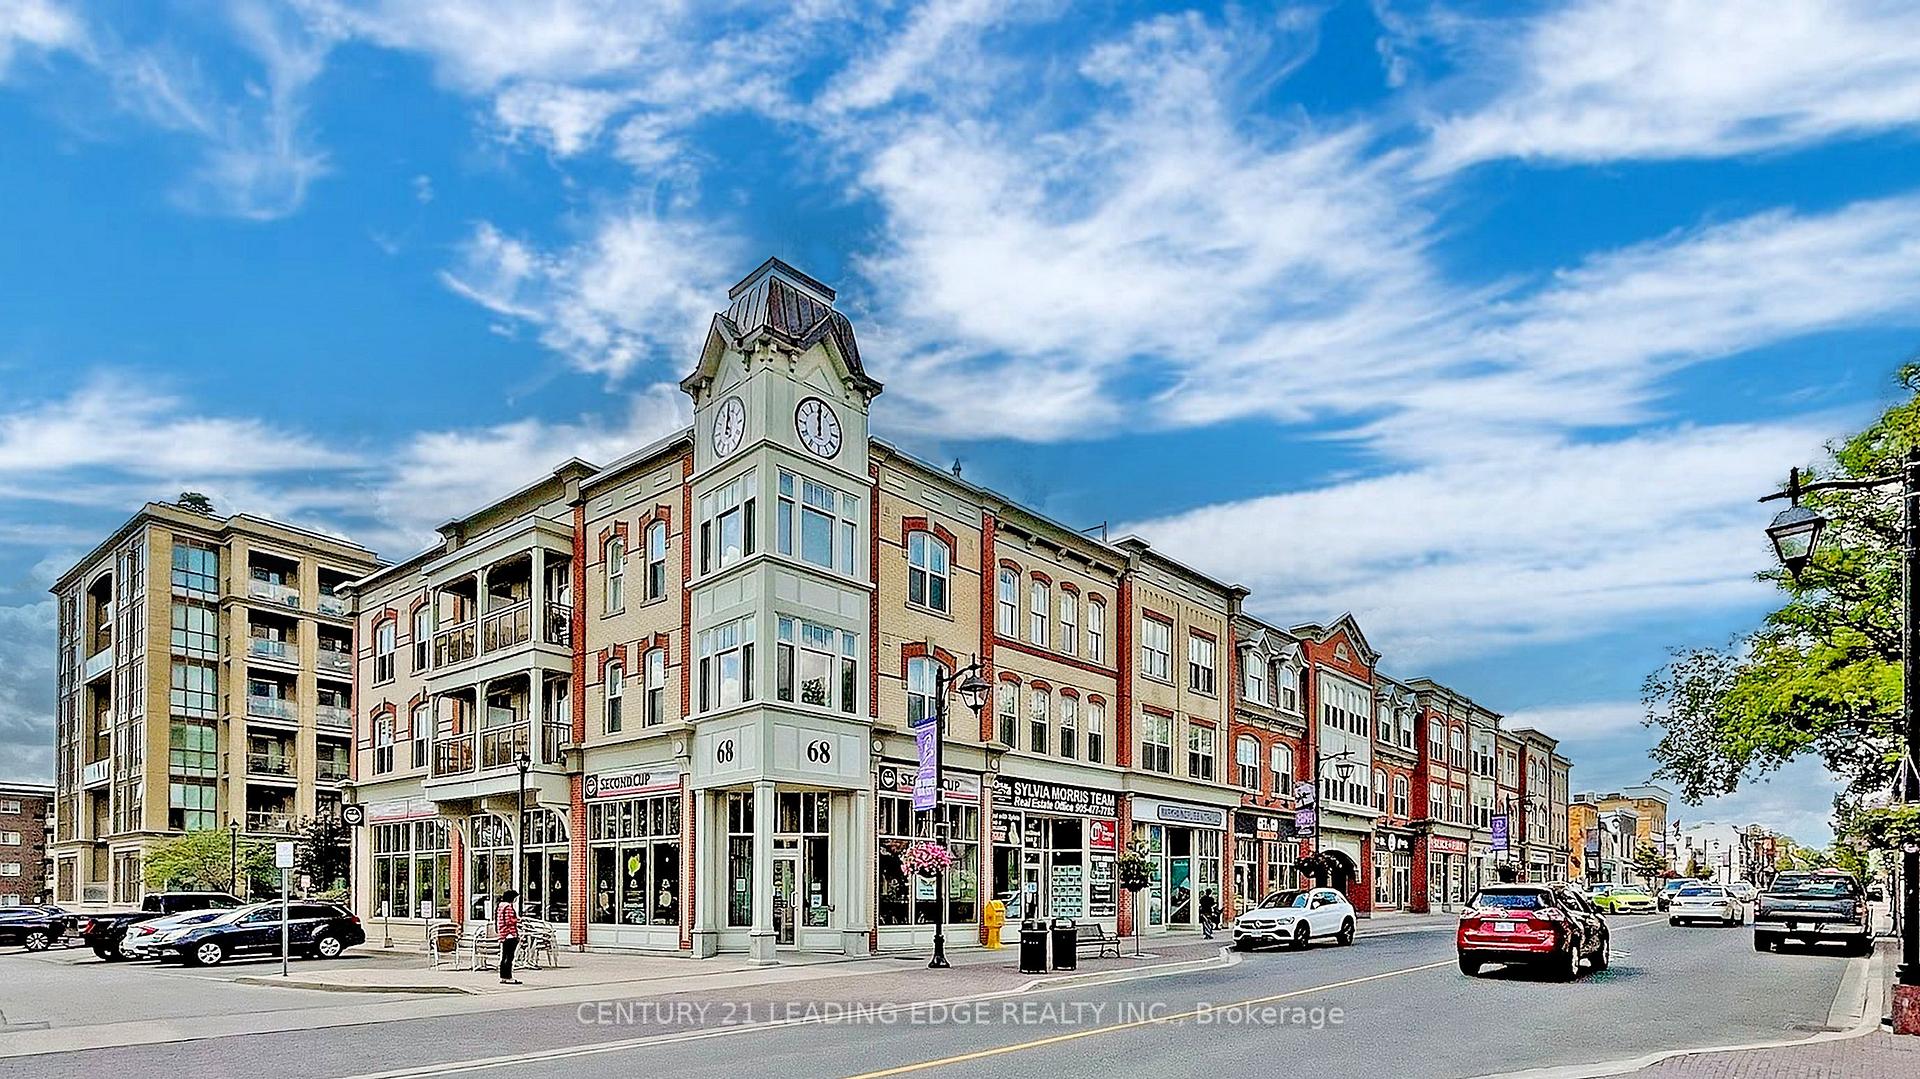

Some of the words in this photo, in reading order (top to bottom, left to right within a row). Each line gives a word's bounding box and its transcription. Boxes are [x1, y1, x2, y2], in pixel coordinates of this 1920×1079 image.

[717, 739, 734, 764] 68
[807, 740, 831, 764] 68
[600, 775, 632, 790] SECOND
[633, 772, 651, 787] CUP
[1014, 782, 1051, 799] SYLVIA
[1052, 787, 1089, 804] MORRIS
[1090, 792, 1116, 807] TEAM
[1014, 796, 1031, 808] Real
[1031, 797, 1053, 810] Estate
[1054, 801, 1074, 813] Office
